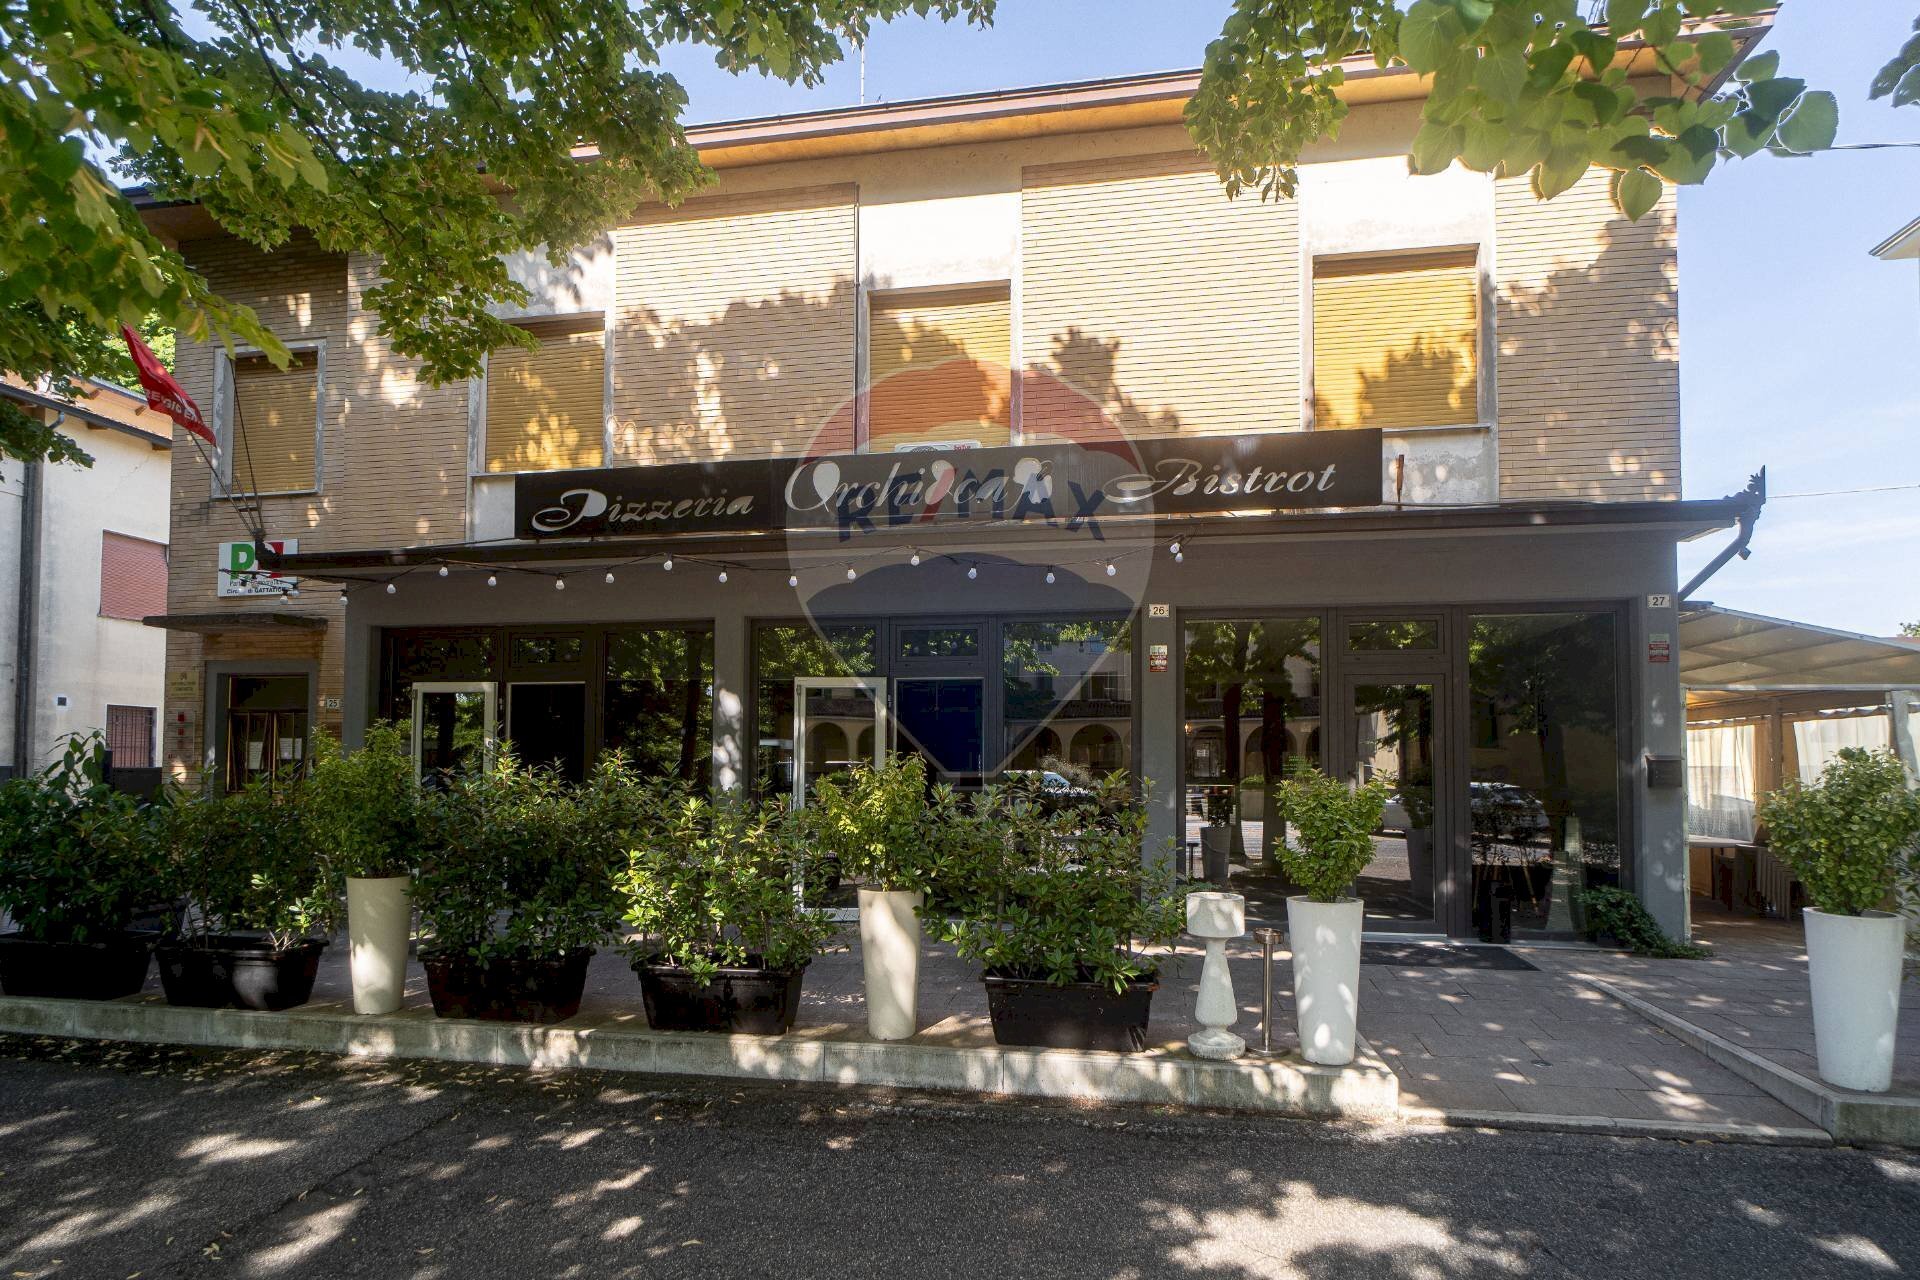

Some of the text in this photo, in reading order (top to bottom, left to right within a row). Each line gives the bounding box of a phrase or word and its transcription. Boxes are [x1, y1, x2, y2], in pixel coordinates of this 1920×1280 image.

[531, 488, 755, 532] Pizzeria
[1101, 458, 1337, 503] Bistrot
[1652, 596, 1665, 606] 27
[1153, 606, 1165, 615] 26
[328, 699, 338, 708] 25
